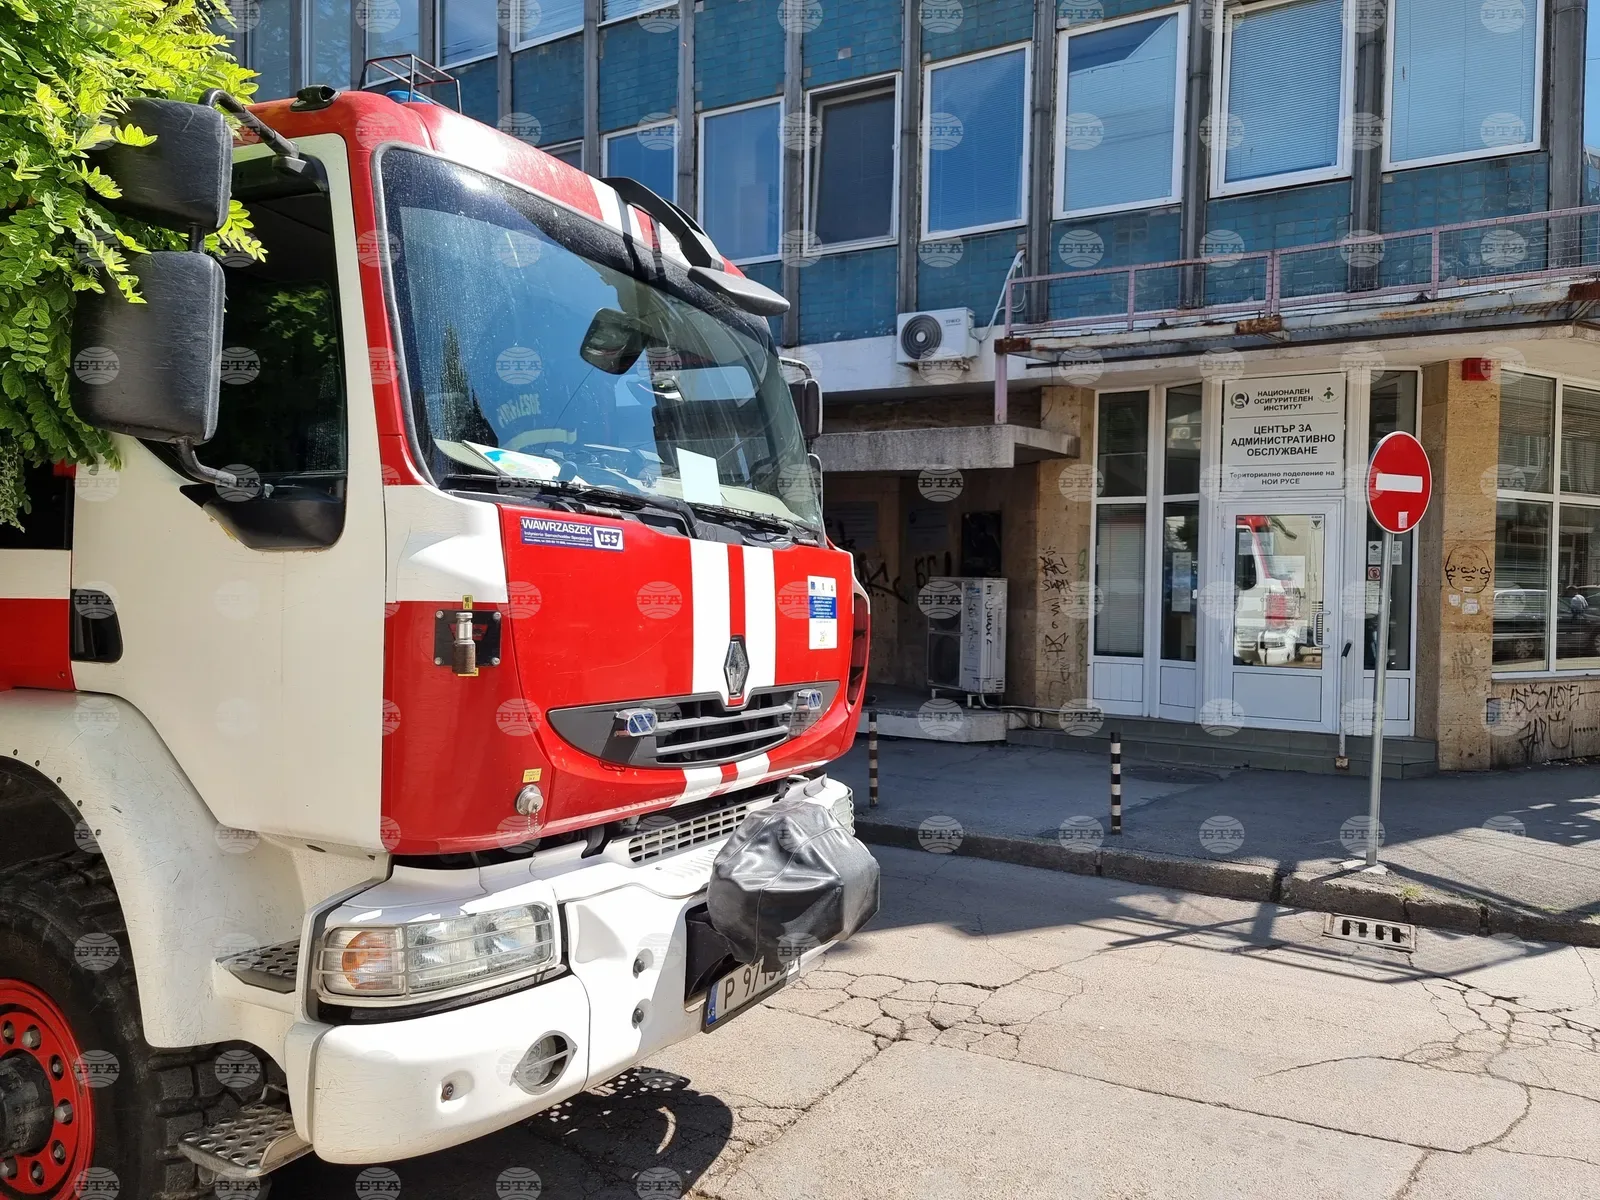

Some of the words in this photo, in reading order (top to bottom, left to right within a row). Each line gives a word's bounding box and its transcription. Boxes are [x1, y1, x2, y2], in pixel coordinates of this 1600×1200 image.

[1257, 388, 1310, 397] НАЦИОНАЛЕН
[1254, 395, 1314, 404] ОСИГУРИТЕЛЕН
[1254, 425, 1295, 435] ЦЕНТЪР
[1298, 424, 1312, 432] ЗА
[1231, 434, 1336, 447] АДМИНИСТРАТИВНО
[1247, 446, 1318, 457] ОБСЛУЖВАНЕ
[522, 519, 592, 535] WAWRZASZEK
